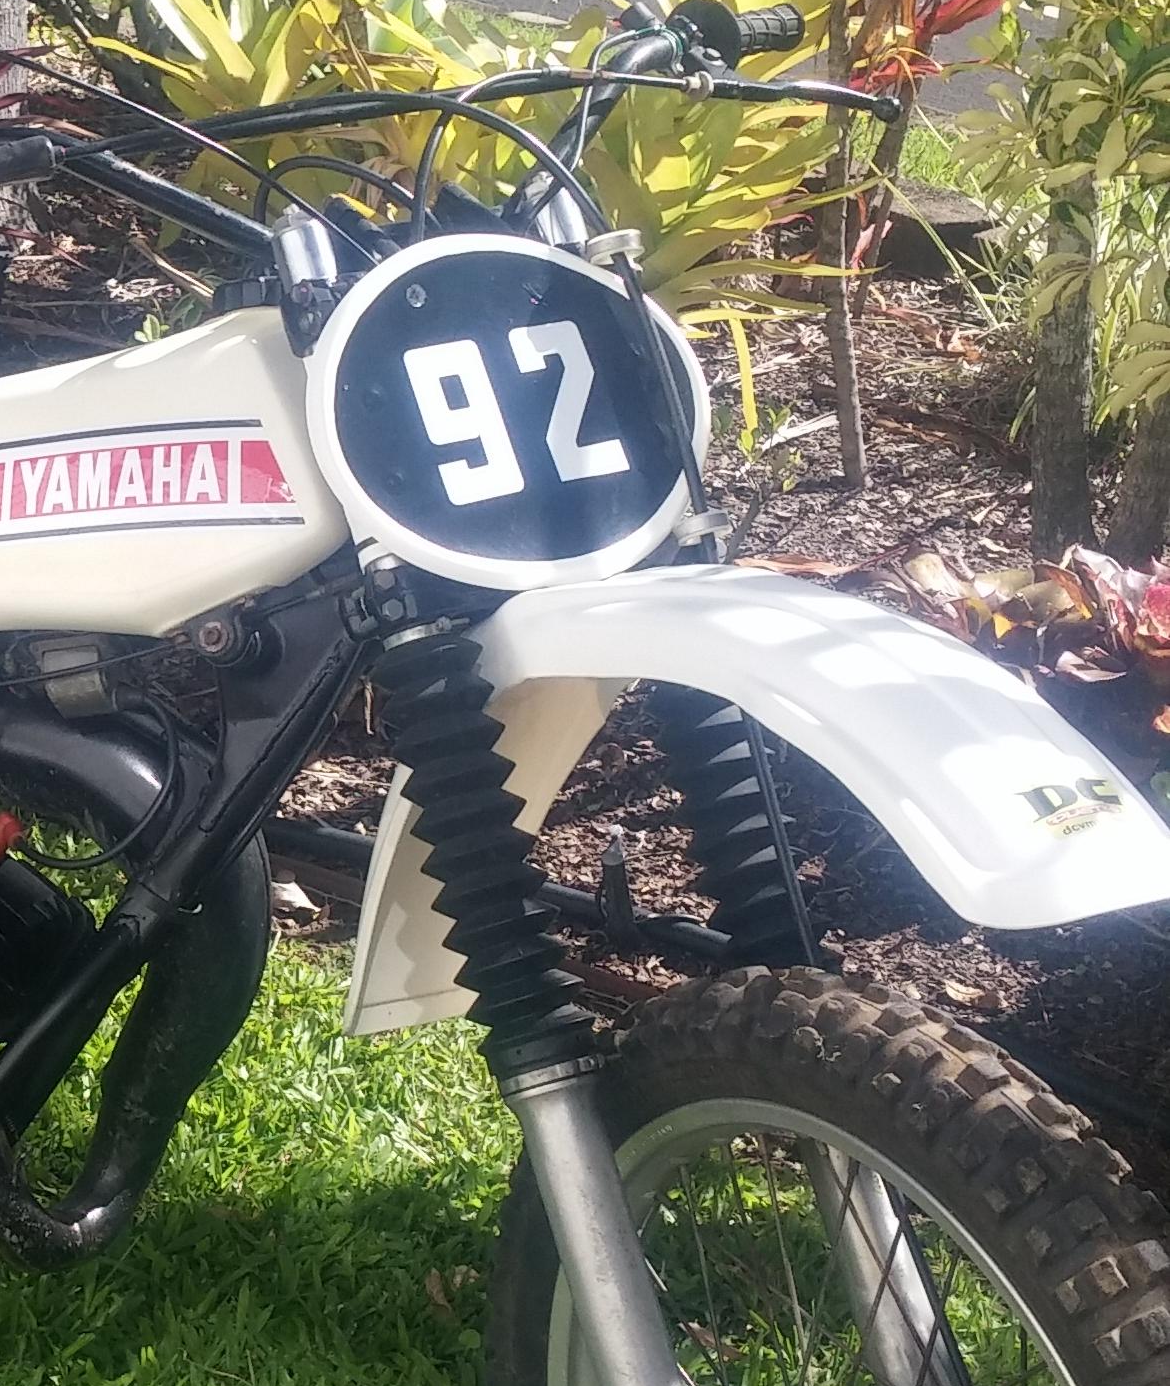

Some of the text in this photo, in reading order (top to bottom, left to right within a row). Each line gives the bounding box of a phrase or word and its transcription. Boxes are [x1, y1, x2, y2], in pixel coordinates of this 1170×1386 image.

[403, 320, 630, 506] 92
[20, 444, 222, 516] YAMAHA
[1014, 777, 1123, 823] DC
